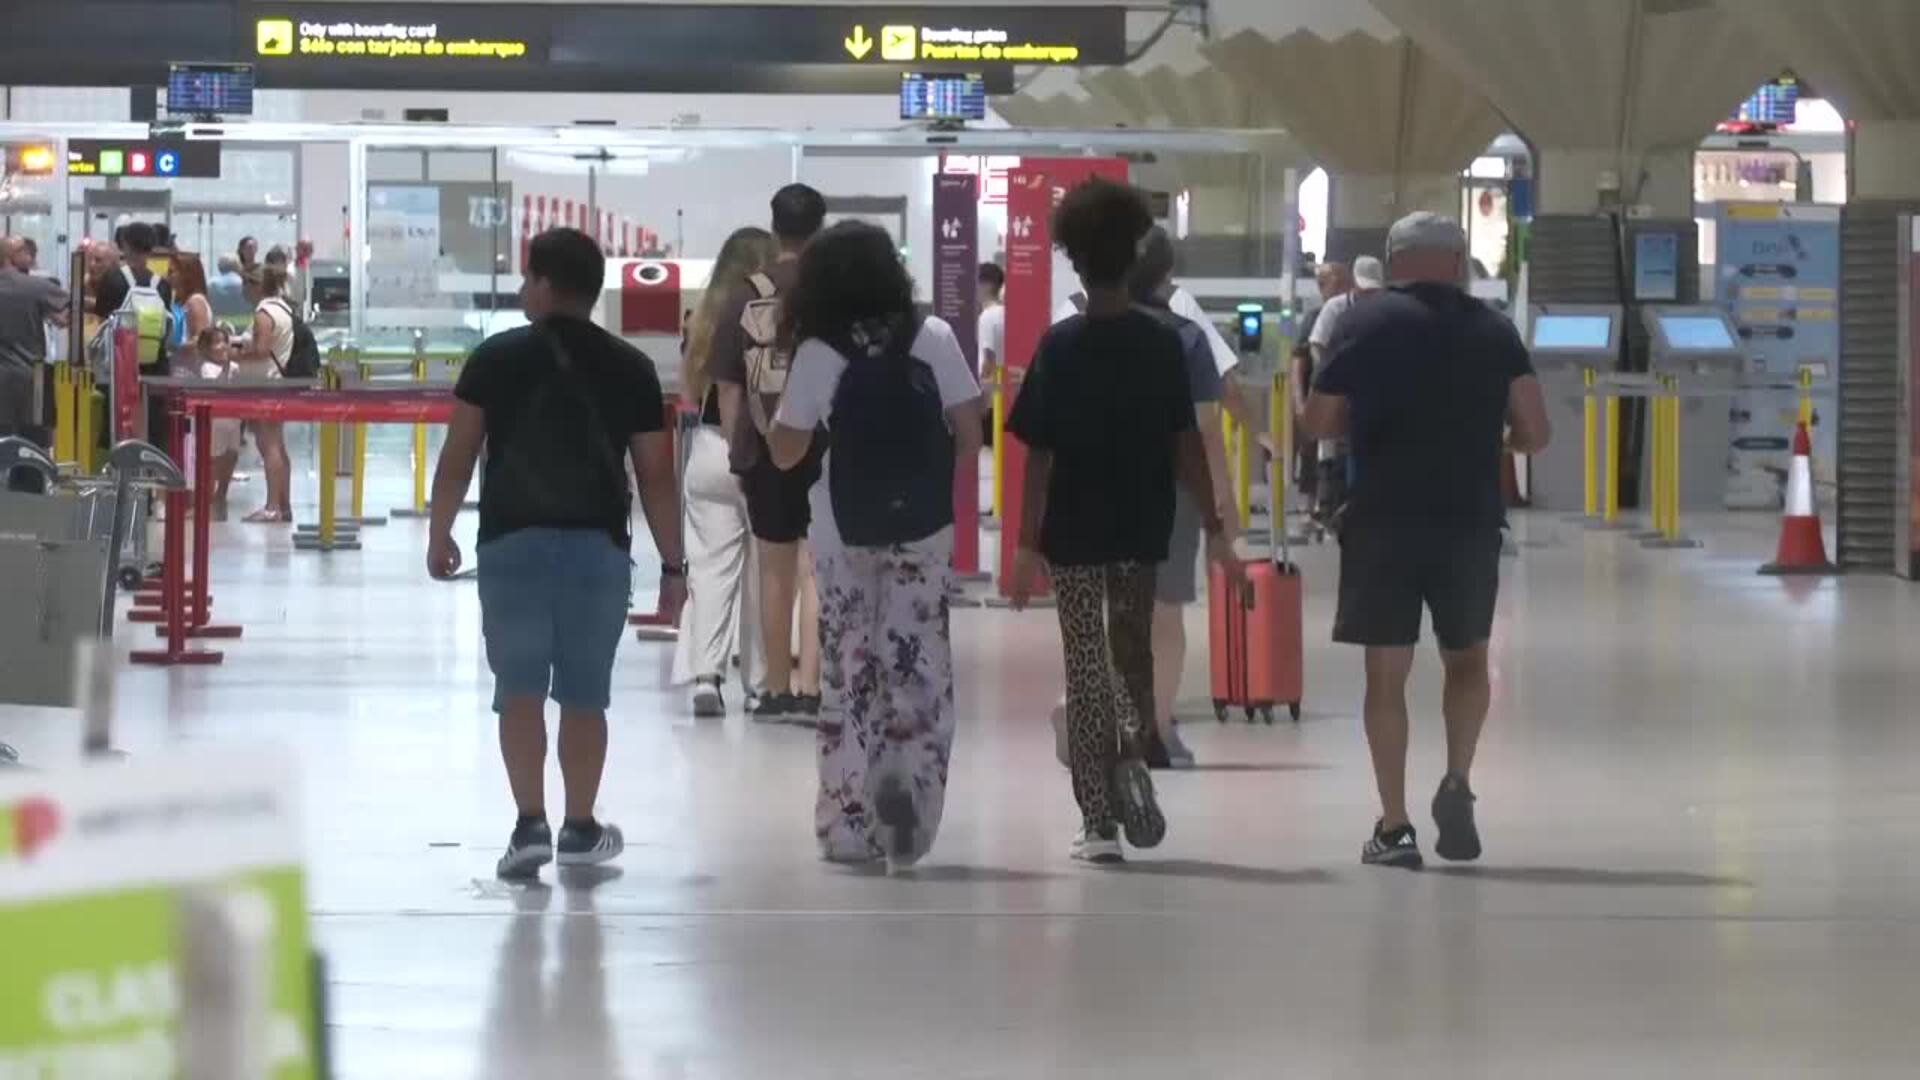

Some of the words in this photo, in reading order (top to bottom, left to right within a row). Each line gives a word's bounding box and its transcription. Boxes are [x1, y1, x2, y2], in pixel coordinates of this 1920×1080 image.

[300, 23, 326, 38] Only
[328, 24, 353, 37] with
[354, 24, 407, 39] boarding
[408, 24, 437, 37] card
[336, 40, 366, 54] con
[368, 39, 422, 57] tarjeta
[423, 39, 444, 54] de
[446, 39, 525, 58] embarque
[981, 43, 1002, 59] de
[1002, 43, 1079, 62] embarque
[131, 153, 146, 172] B
[159, 153, 174, 172] C
